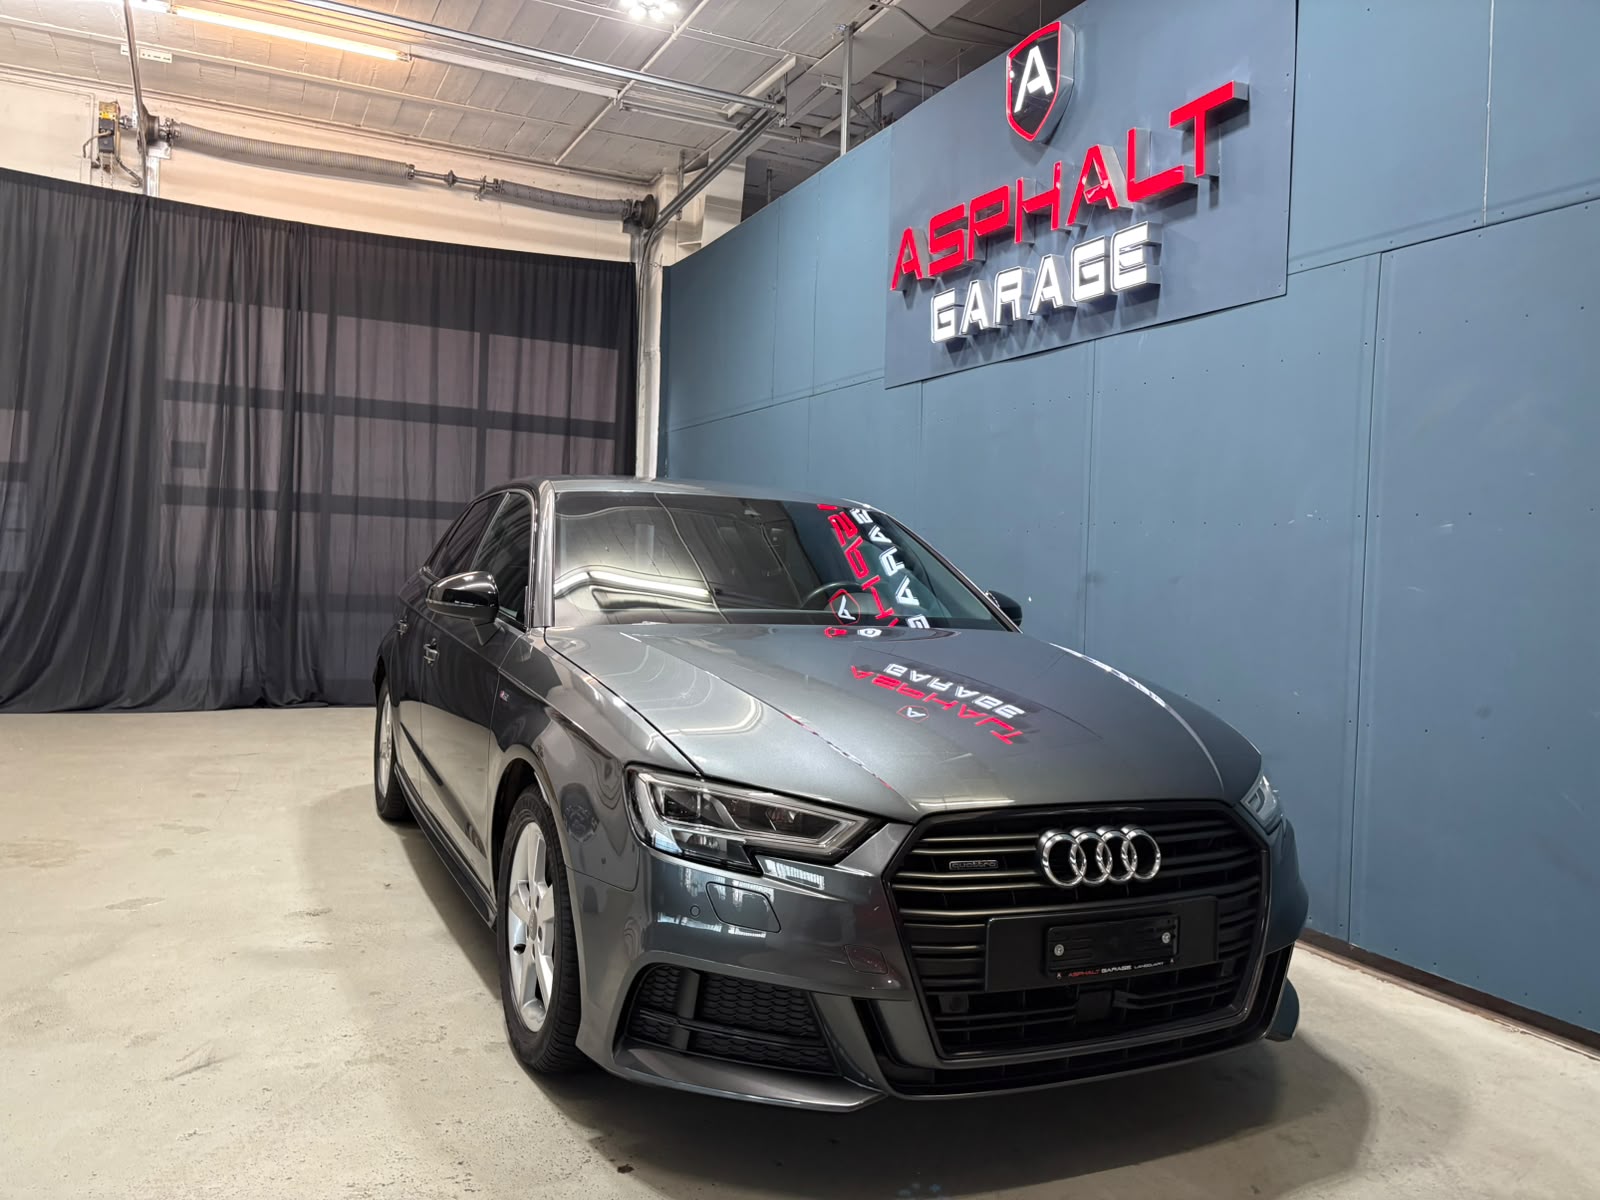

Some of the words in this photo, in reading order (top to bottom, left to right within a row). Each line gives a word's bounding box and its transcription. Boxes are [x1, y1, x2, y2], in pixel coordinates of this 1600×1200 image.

[1014, 46, 1054, 113] A
[890, 80, 1236, 291] ASPHALT
[931, 221, 1152, 344] GARAGE
[1068, 969, 1100, 977] ASPHALT
[1101, 965, 1132, 974] GARAGE
